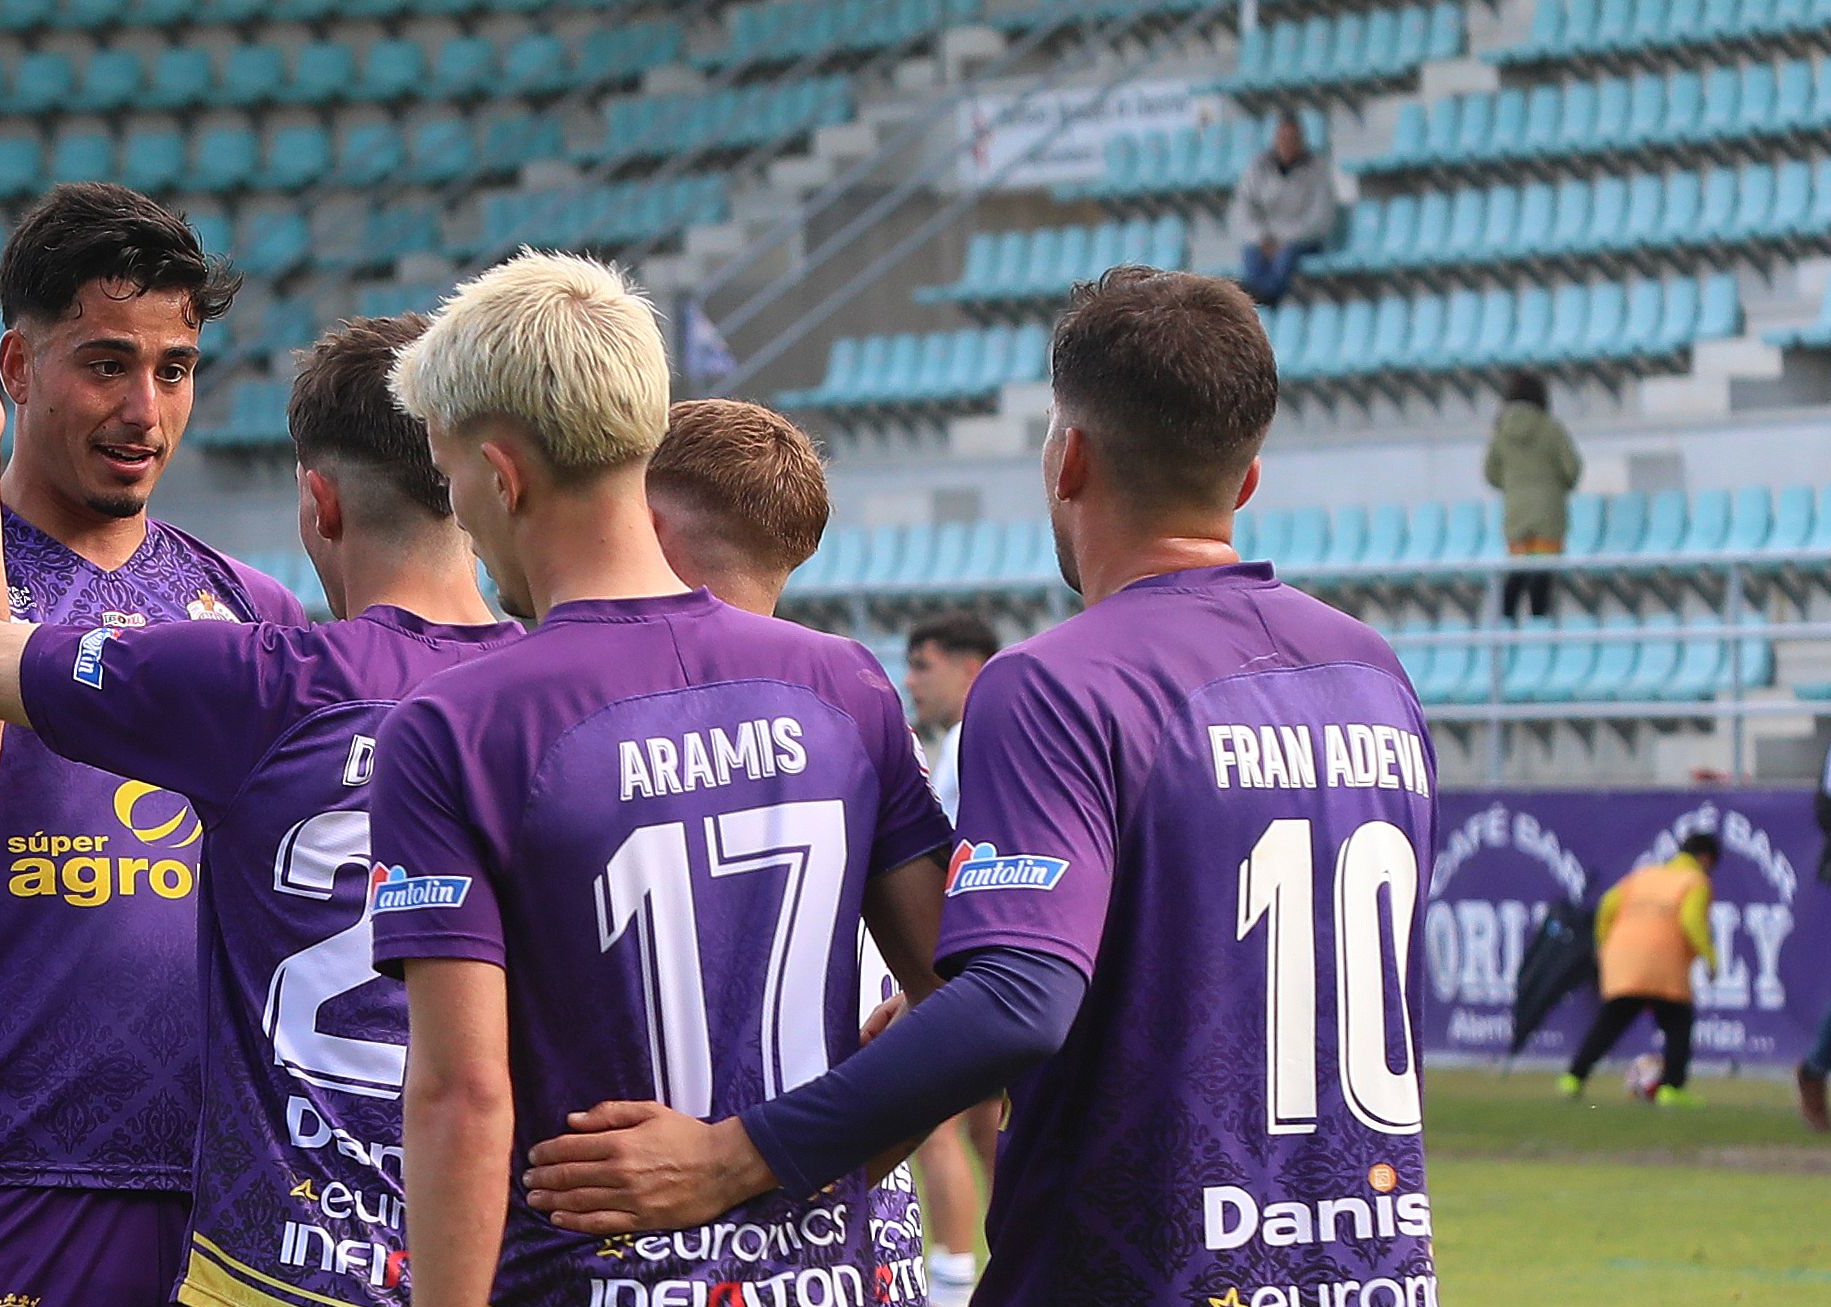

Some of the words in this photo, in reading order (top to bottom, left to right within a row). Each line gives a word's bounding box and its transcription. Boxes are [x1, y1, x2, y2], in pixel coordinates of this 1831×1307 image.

[619, 716, 807, 801] ARAMIS
[1207, 724, 1317, 789] FRAN
[1324, 723, 1430, 799] ADEVA
[7, 829, 109, 856] súper
[959, 860, 1048, 888] antolin
[8, 854, 201, 907] agro
[378, 880, 455, 908] antolin
[593, 799, 848, 1118] 17
[1236, 818, 1423, 1136] 10
